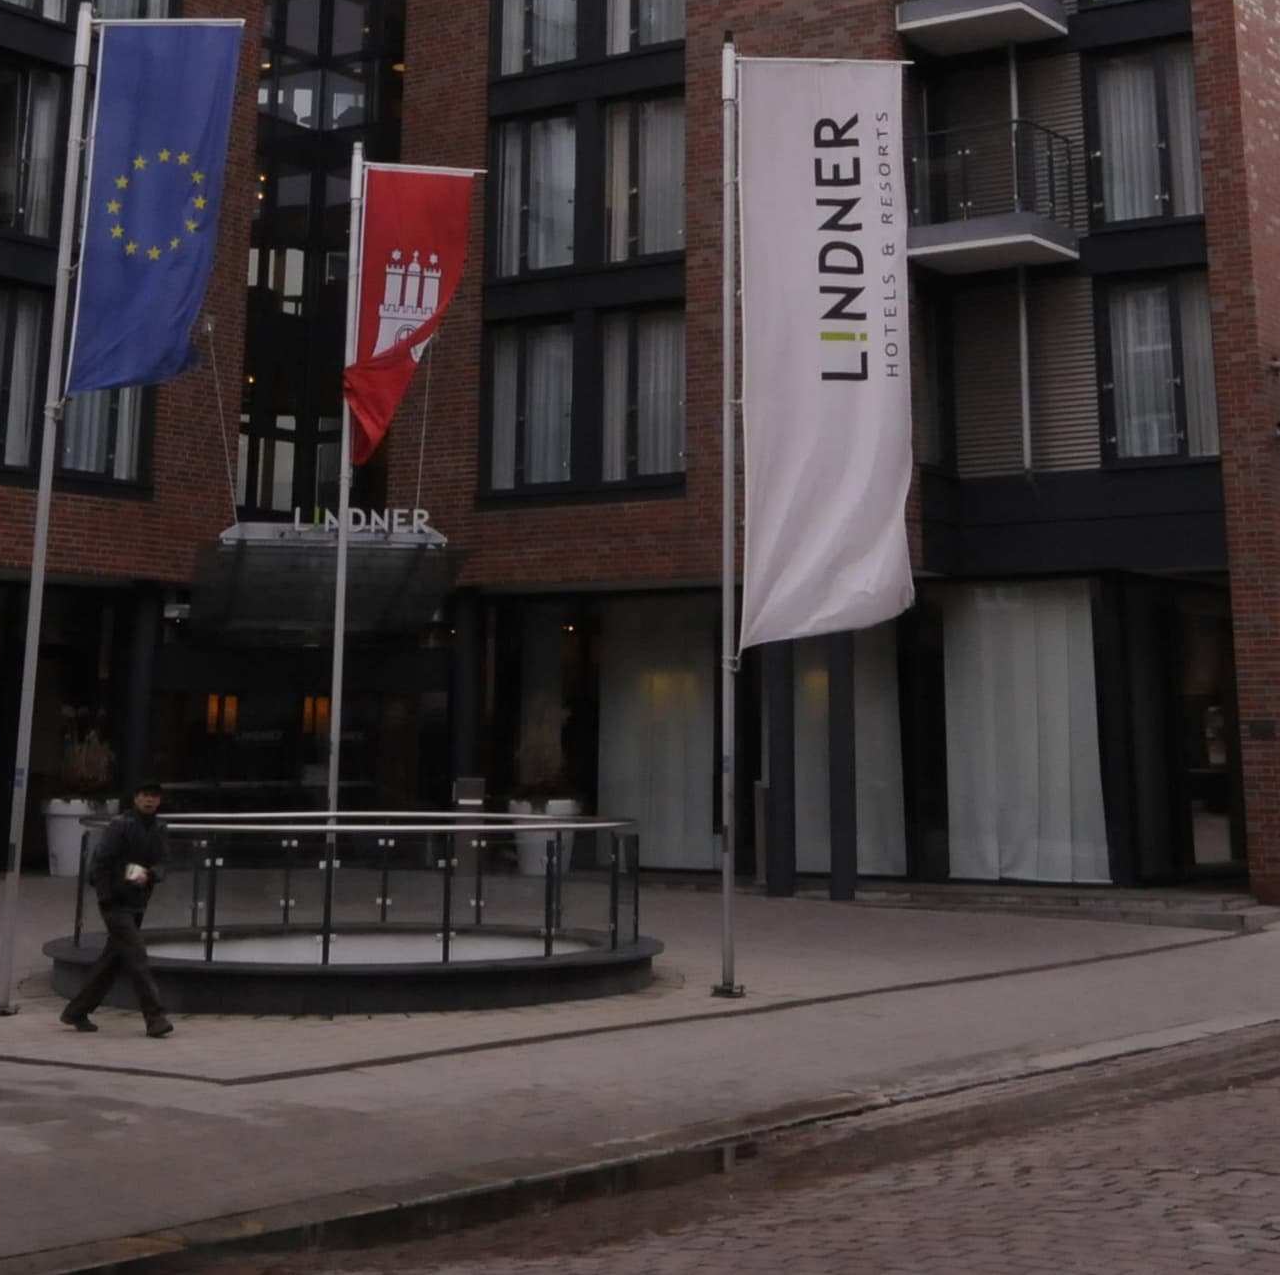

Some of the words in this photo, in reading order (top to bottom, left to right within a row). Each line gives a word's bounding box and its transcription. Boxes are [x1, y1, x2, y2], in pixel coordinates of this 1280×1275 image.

[876, 111, 894, 225] RESORTS
[882, 242, 896, 257] &
[883, 273, 899, 377] HOTELS
[294, 506, 429, 534] LINDNER
